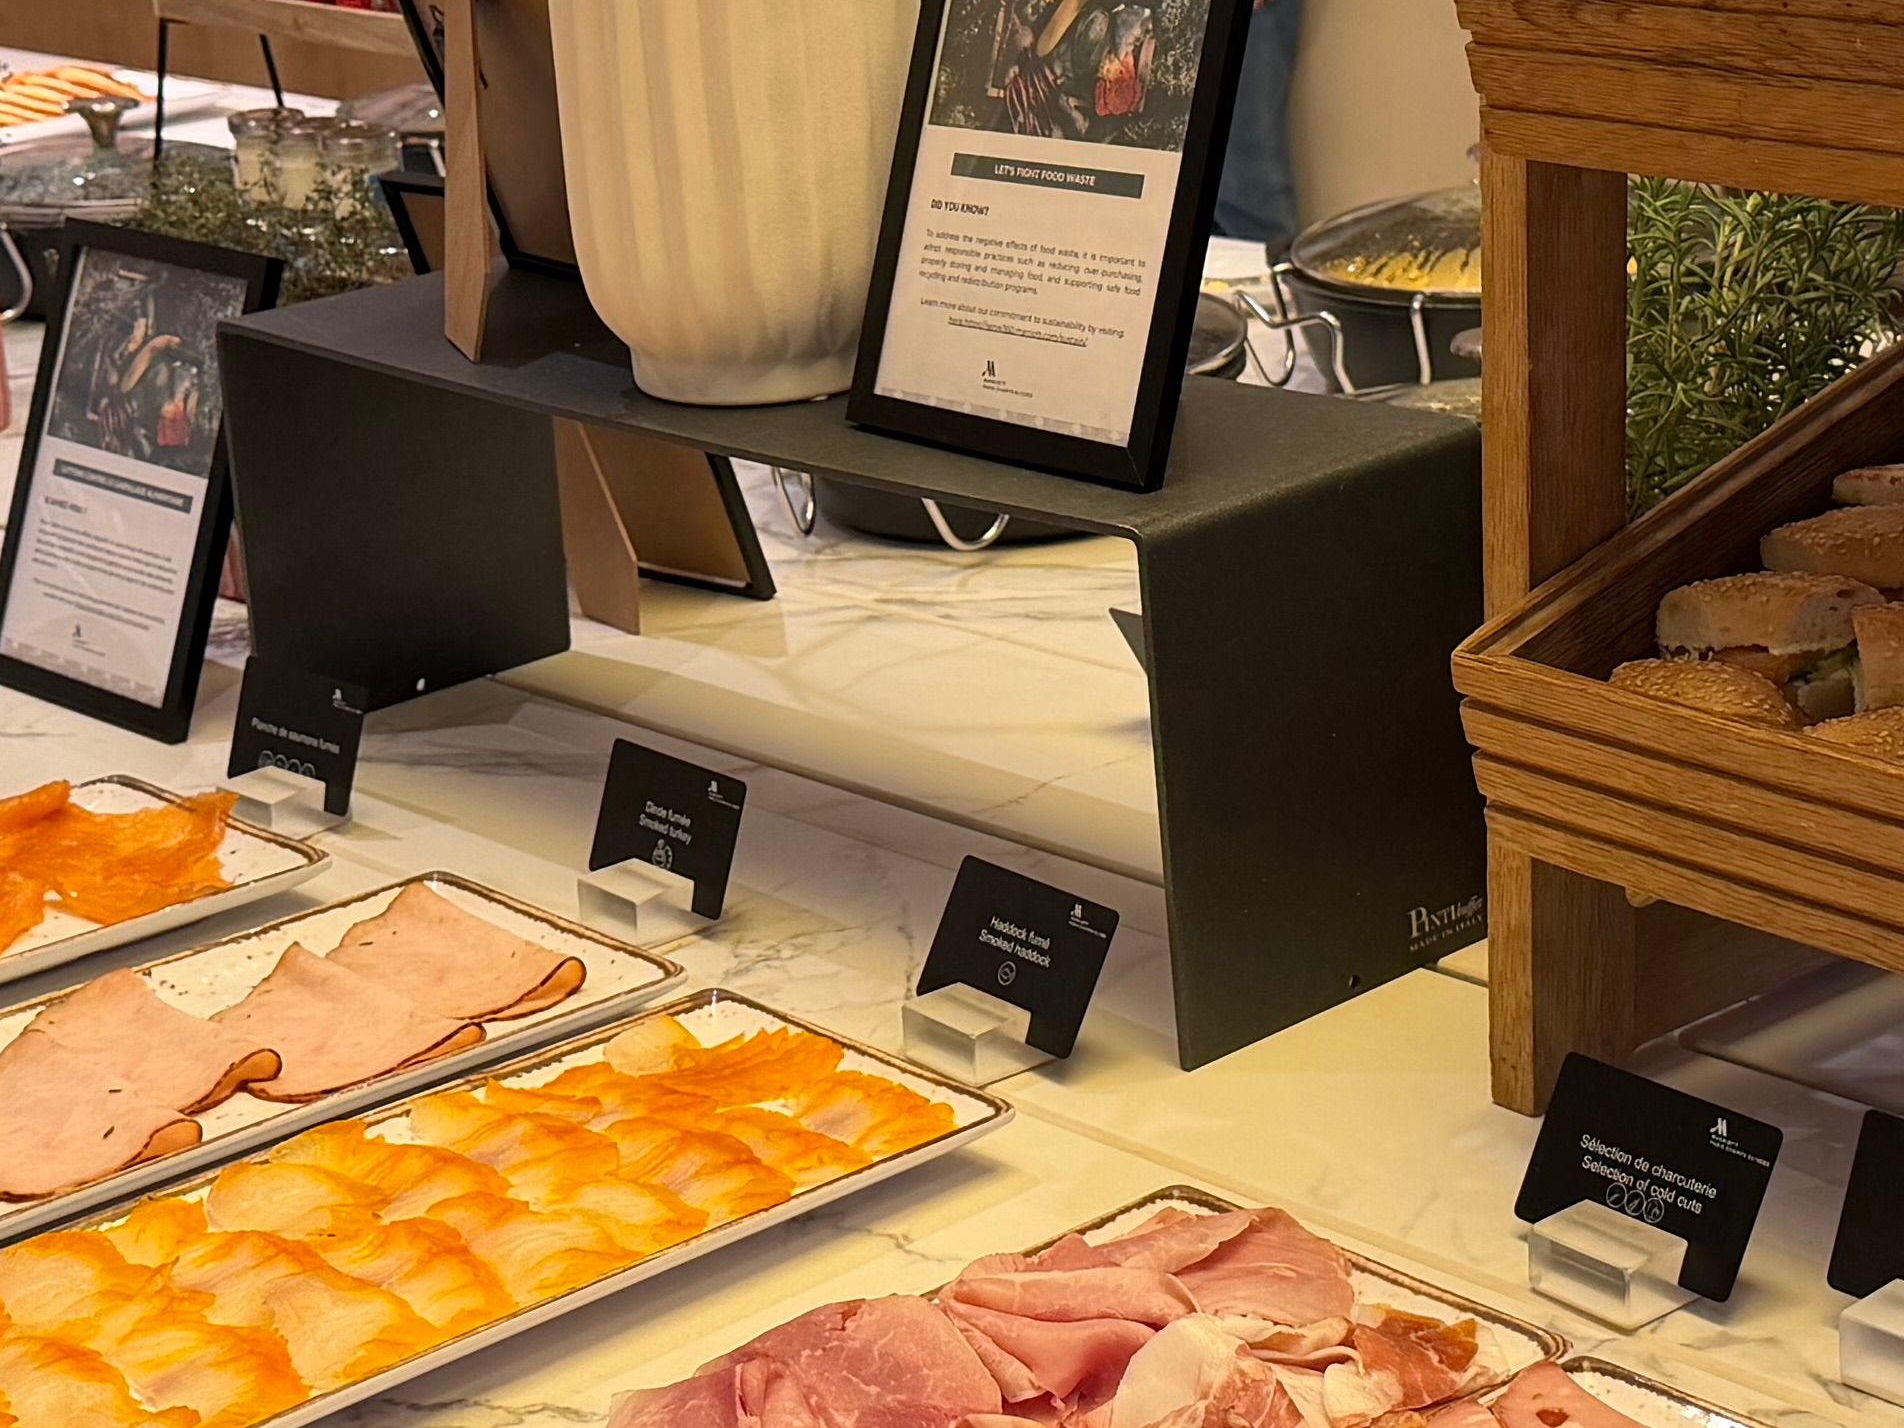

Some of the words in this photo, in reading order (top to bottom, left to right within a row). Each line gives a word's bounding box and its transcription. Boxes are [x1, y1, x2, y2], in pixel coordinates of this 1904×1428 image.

[994, 163, 1015, 176] LET'S
[1016, 167, 1040, 180] FIGHT
[1041, 170, 1065, 183] FOOD
[1066, 173, 1096, 187] WASTE
[931, 198, 943, 210] DID
[945, 201, 960, 213] YOU
[960, 203, 990, 217] KNOW?
[945, 246, 982, 258] responsible
[984, 252, 1014, 263] practices
[1017, 257, 1034, 266] such
[1037, 260, 1046, 268] as
[1049, 262, 1080, 275] reducing
[962, 234, 973, 243] the
[975, 237, 1004, 247] negative
[1029, 243, 1038, 252] of
[1040, 245, 1056, 255] food
[1099, 255, 1136, 267] important
[1138, 259, 1146, 268] to
[920, 257, 947, 268] properly
[949, 261, 972, 273] storing
[974, 265, 988, 273] and
[990, 267, 1025, 280] managing
[1047, 276, 1062, 285] and
[1064, 278, 1104, 292] supporting
[1124, 286, 1141, 297] food
[947, 275, 960, 283] and
[920, 298, 938, 307] Learn
[939, 300, 956, 310] more
[957, 303, 977, 313] about
[977, 307, 988, 315] our
[1034, 315, 1041, 324] to
[1042, 318, 1086, 332] sustainability
[1087, 324, 1097, 335] by
[645, 800, 667, 818] Dinde
[639, 813, 669, 835] Smoked
[669, 825, 693, 845] turkey
[978, 928, 1015, 954] Smoked
[1014, 944, 1051, 969] haddock
[989, 915, 1027, 941] Haddock
[1027, 930, 1051, 950] fumé
[1580, 1133, 1633, 1165] Sélection
[1634, 1157, 1650, 1172] de
[1651, 1164, 1718, 1199] charcuterie
[1581, 1155, 1634, 1186] Selection
[1636, 1178, 1651, 1192] of
[1650, 1183, 1676, 1204] cold
[1677, 1196, 1703, 1215] cuts
